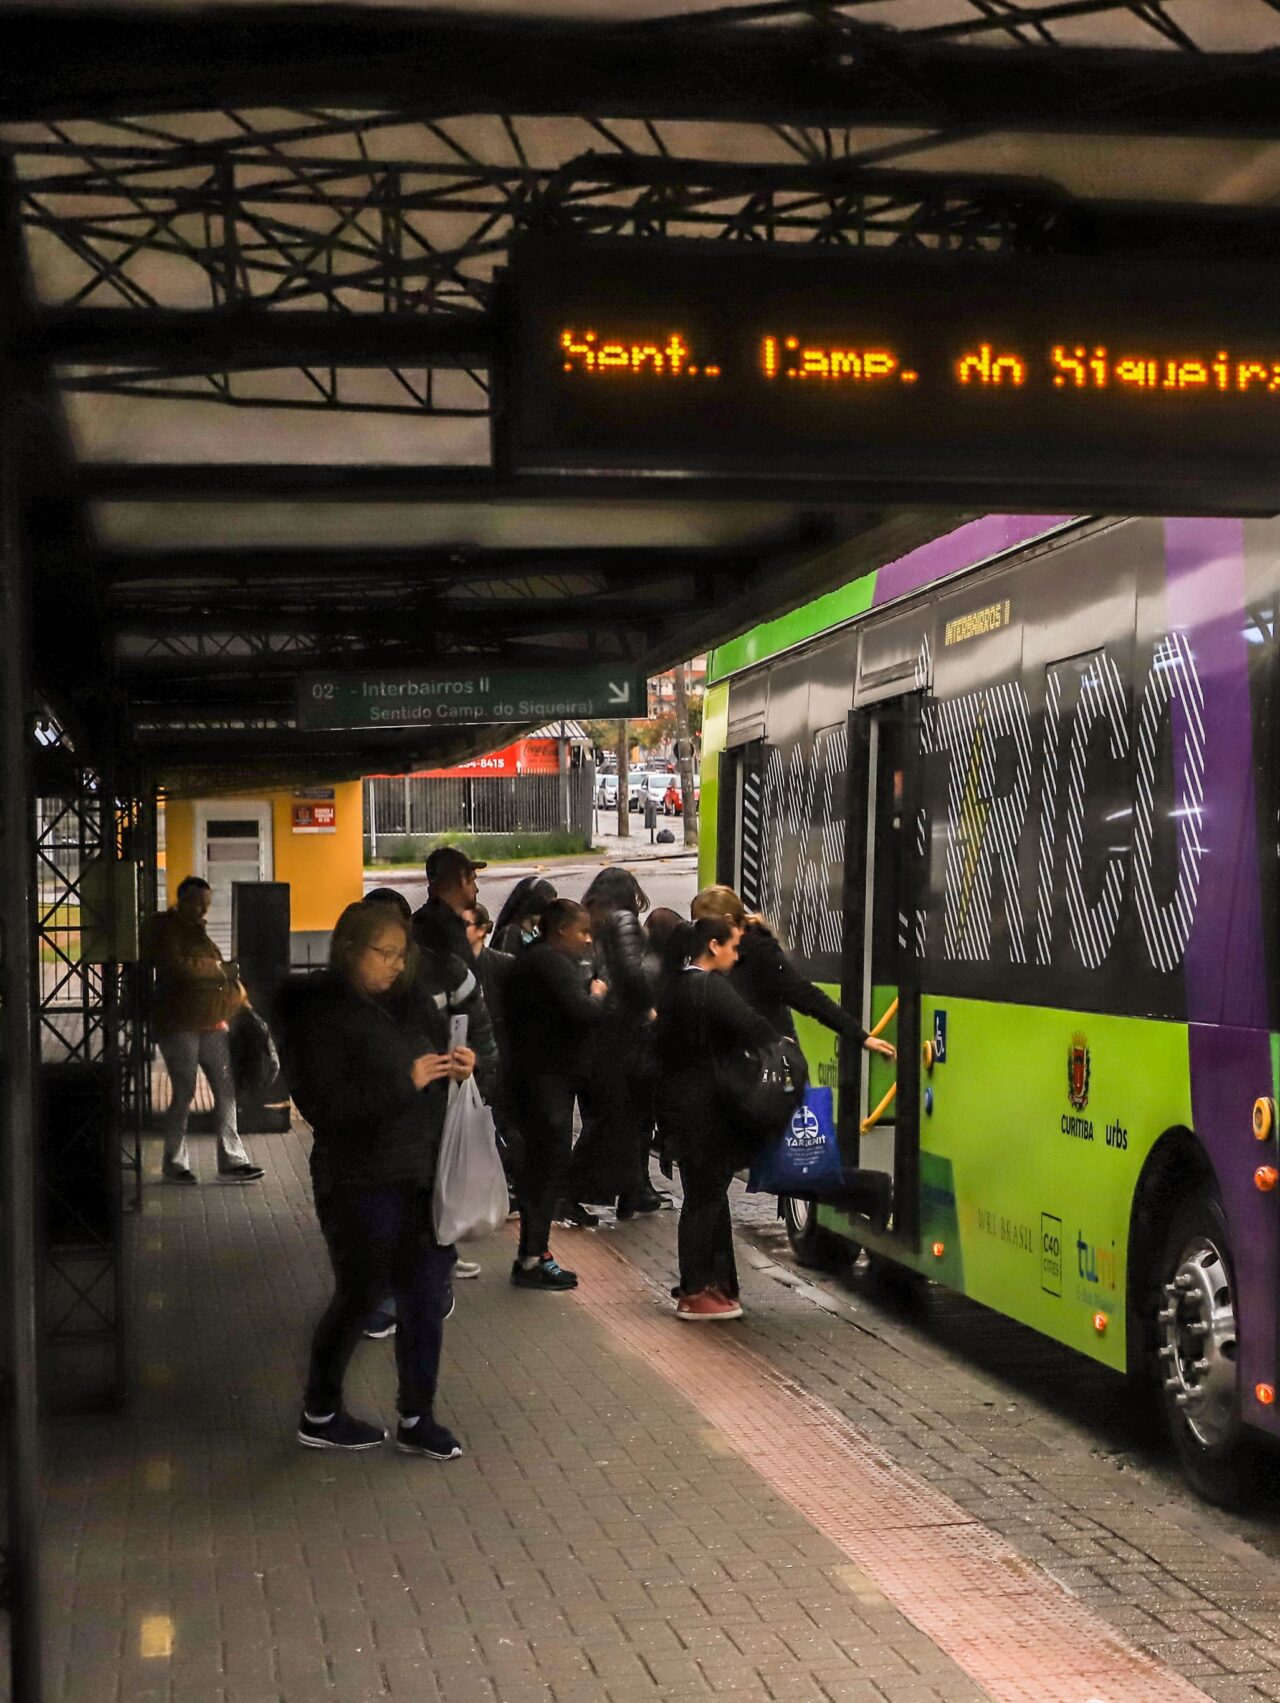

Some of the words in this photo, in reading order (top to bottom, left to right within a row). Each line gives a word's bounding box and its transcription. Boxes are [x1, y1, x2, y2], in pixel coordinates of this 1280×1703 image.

[362, 680, 474, 698] Interbairros
[479, 677, 490, 693] II
[370, 704, 432, 721] Sentido
[436, 704, 488, 720] Camp.
[493, 702, 514, 717] do
[519, 700, 593, 718] Siqueira)
[1061, 1114, 1094, 1141] CURITIBA
[1105, 1118, 1128, 1150] urbs
[978, 1208, 997, 1237] WRI
[1000, 1215, 1033, 1253] BRASIL
[1043, 1233, 1060, 1257] C40
